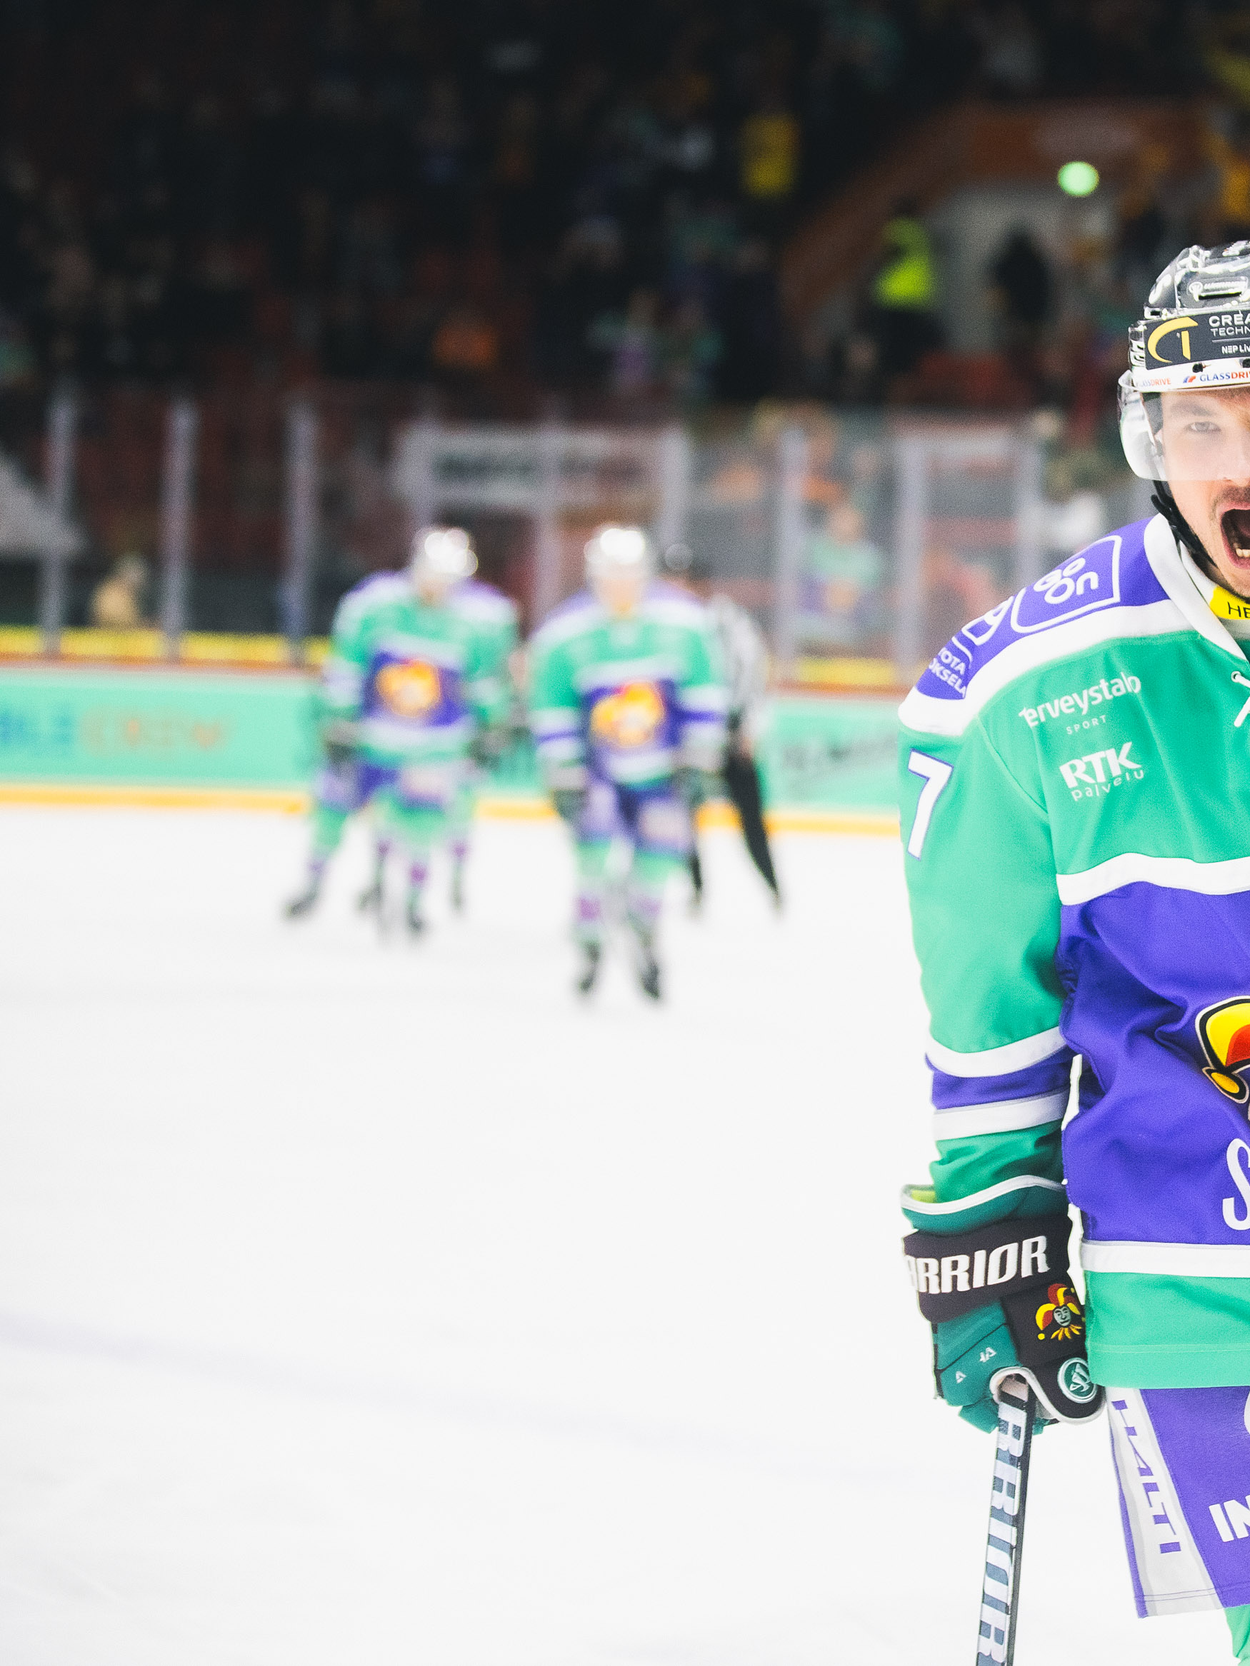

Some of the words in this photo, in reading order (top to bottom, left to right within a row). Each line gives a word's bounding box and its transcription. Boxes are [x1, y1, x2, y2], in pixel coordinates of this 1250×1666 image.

[1221, 345, 1239, 354] NEP
[1066, 714, 1107, 735] SPORT
[1059, 741, 1142, 789] RTK
[906, 747, 955, 860] 7
